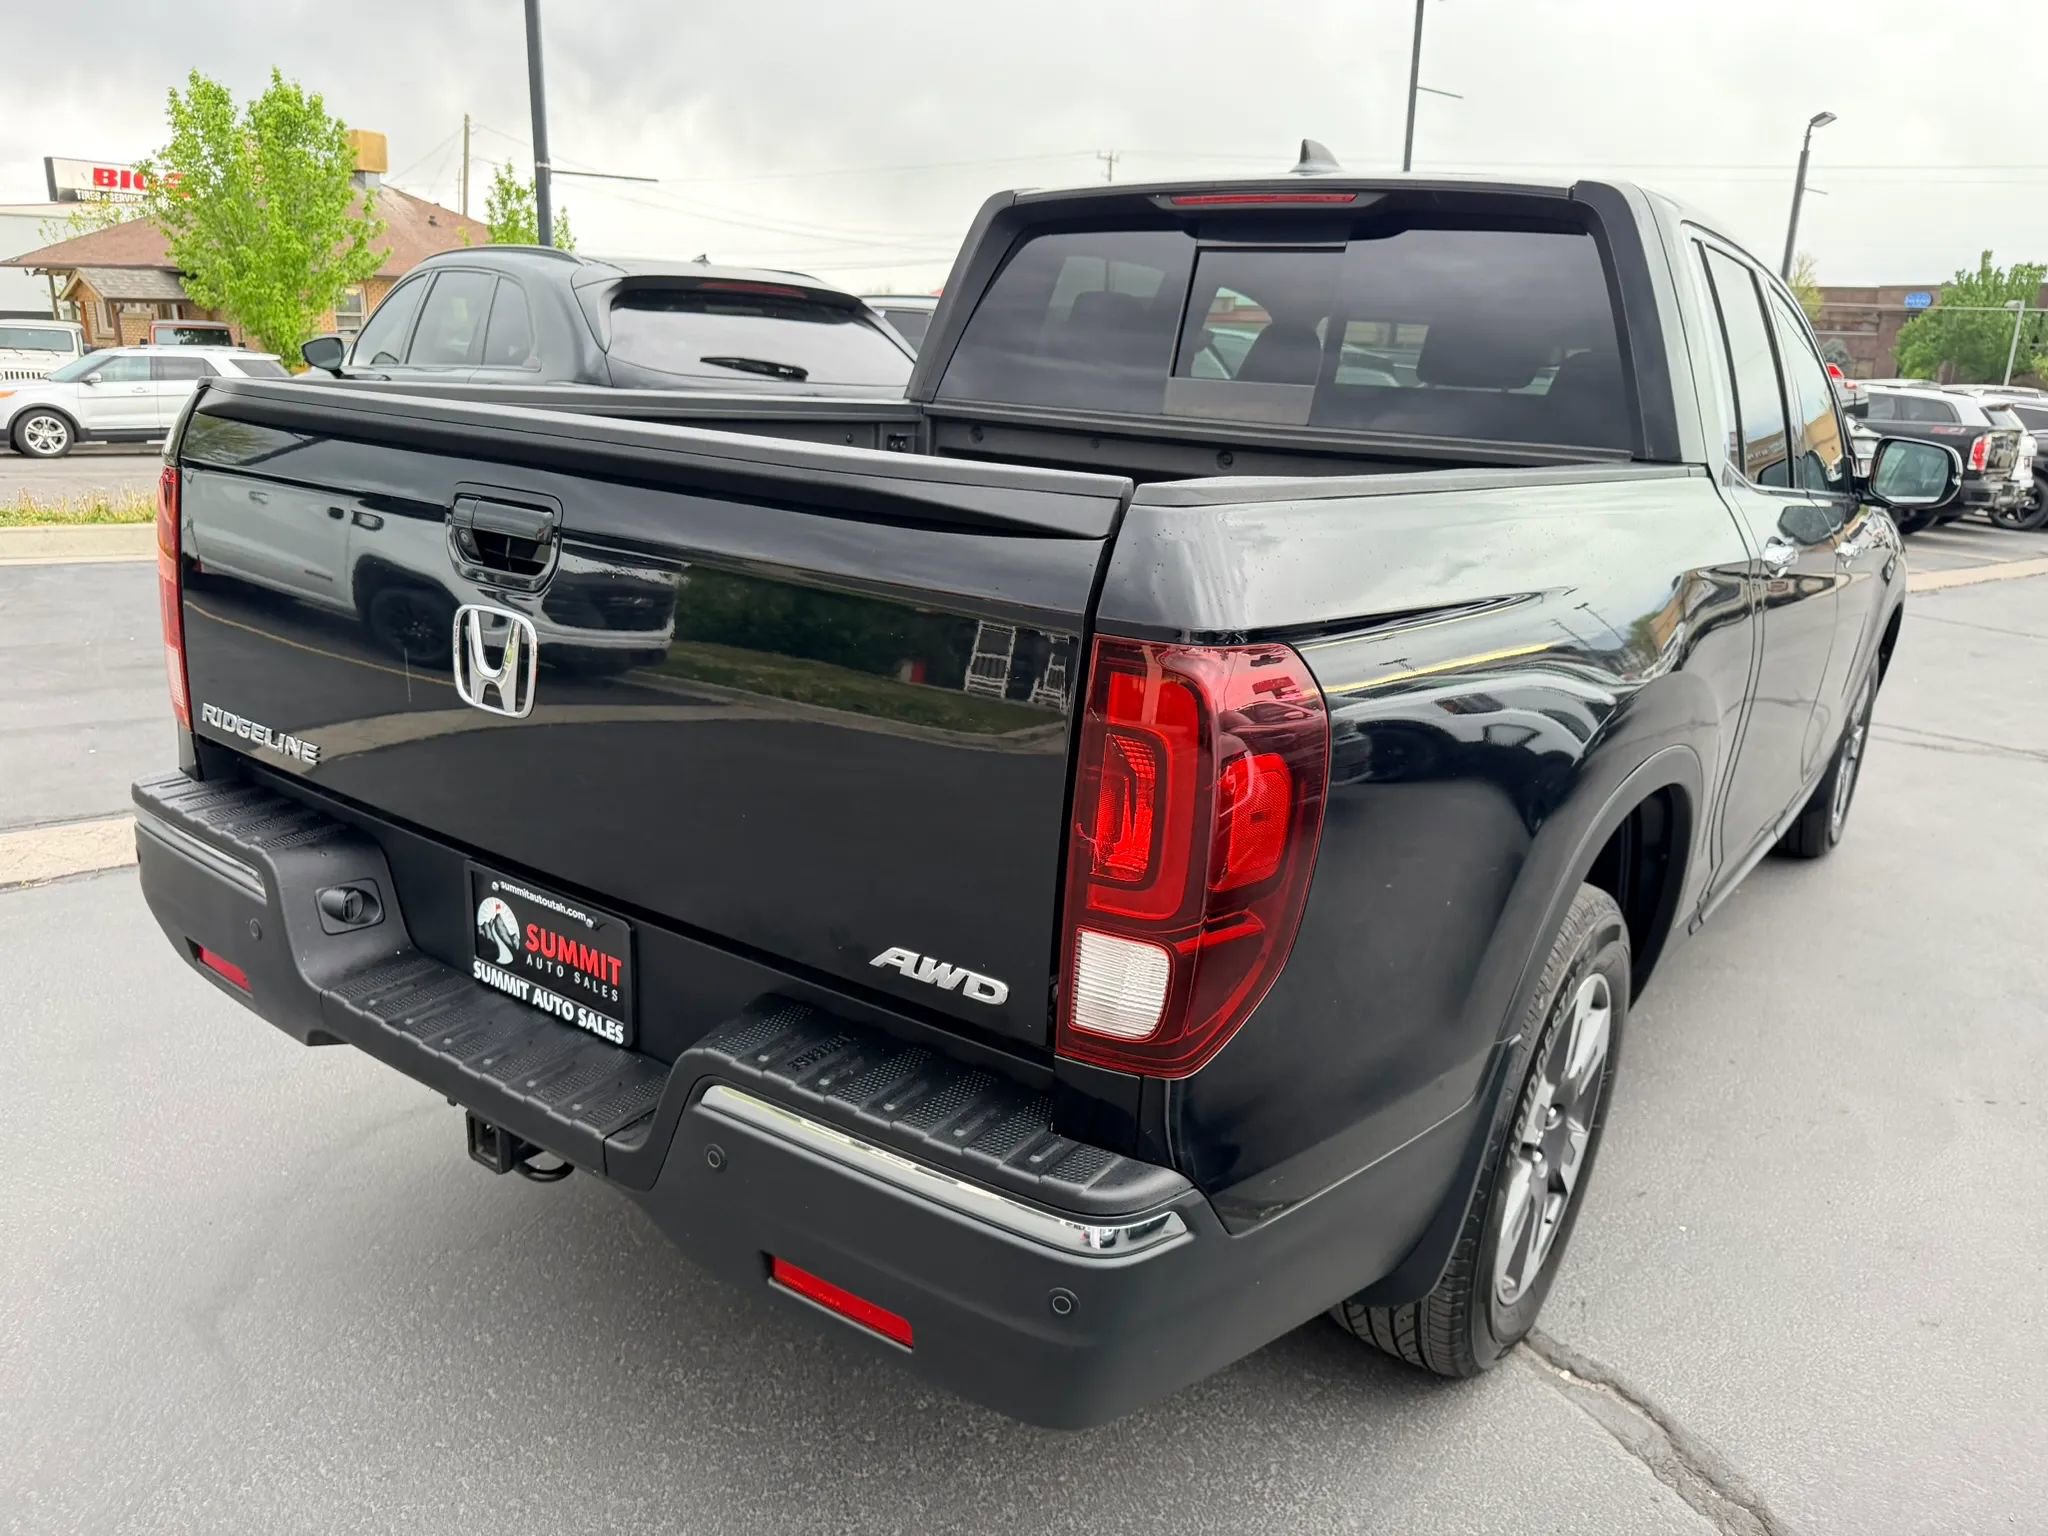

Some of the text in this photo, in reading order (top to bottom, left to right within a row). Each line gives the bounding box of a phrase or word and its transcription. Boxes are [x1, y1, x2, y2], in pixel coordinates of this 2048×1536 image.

[75, 189, 101, 202] TIRES
[201, 702, 321, 765] RIDGELINE
[500, 880, 587, 922] summitautoutah.com
[525, 923, 622, 986] SUMMIT
[526, 954, 619, 1002] AUTO SALES
[869, 947, 1010, 1005] AWD
[473, 961, 624, 1044] SUMMIT AUTO SALES
